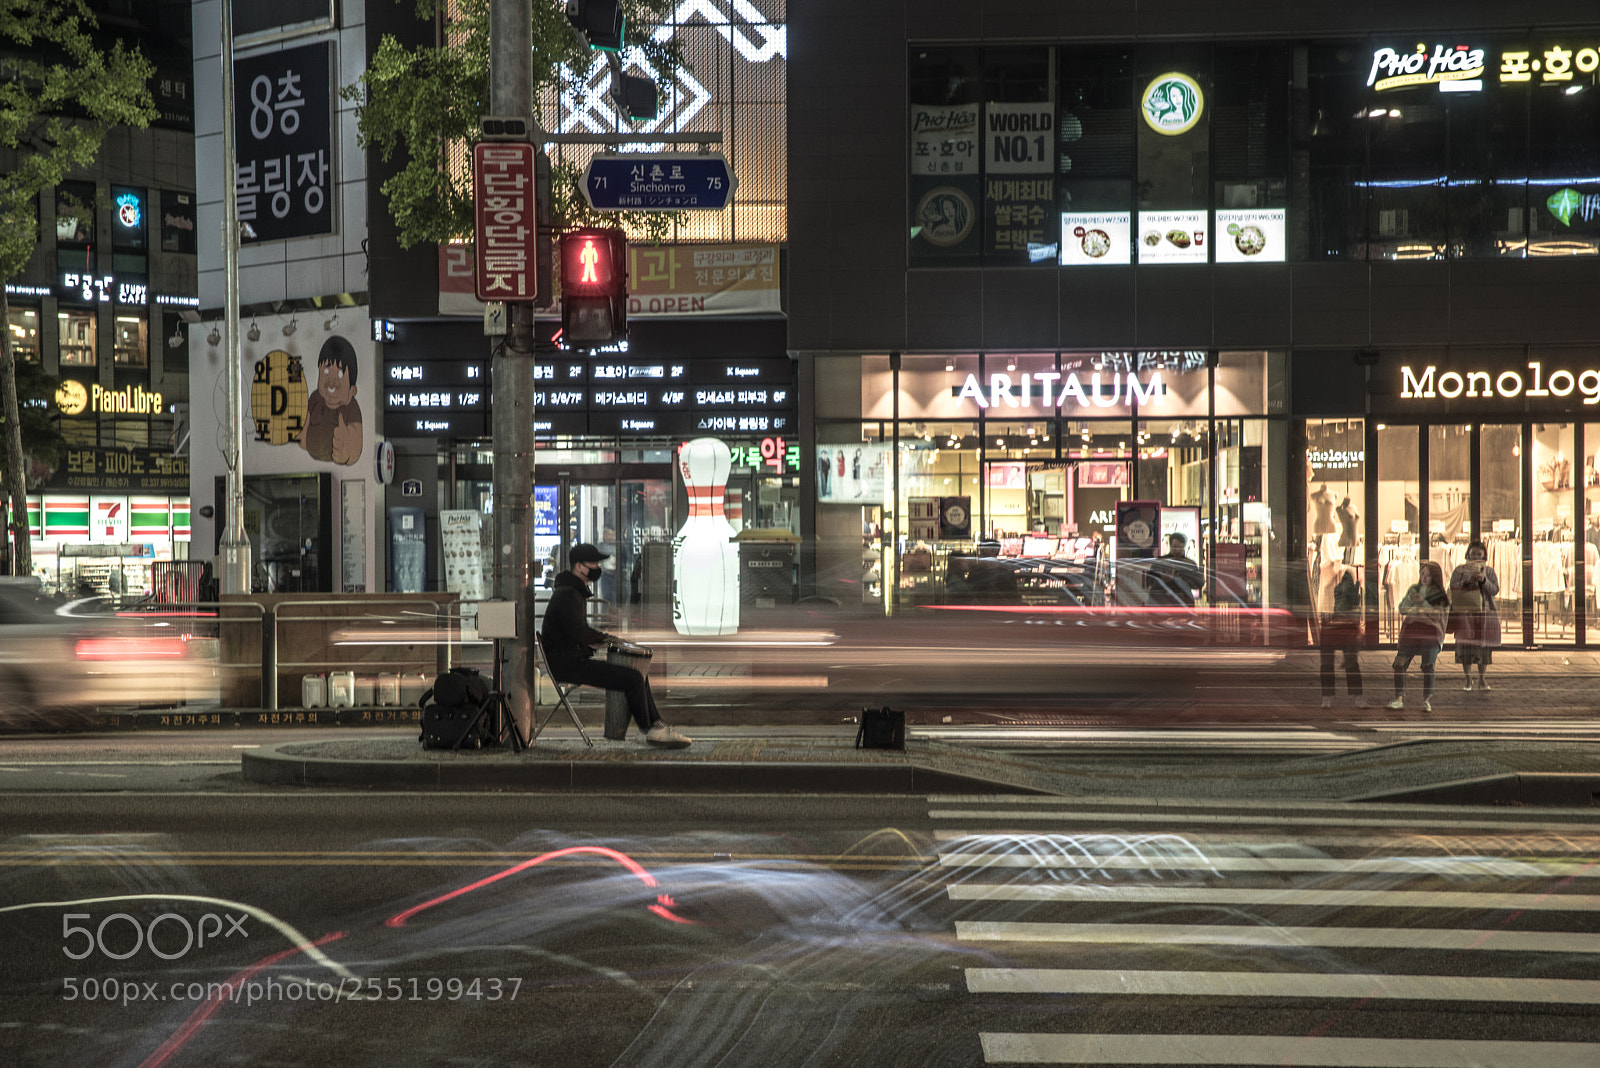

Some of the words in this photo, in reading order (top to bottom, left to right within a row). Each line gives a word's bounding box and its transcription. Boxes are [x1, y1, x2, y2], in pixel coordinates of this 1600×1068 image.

[160, 79, 186, 99] 센터
[250, 69, 305, 140] 8층
[989, 113, 1052, 132] WORLD
[994, 135, 1045, 162] NO.1
[631, 164, 685, 182] 신촌로
[236, 149, 329, 220] 볼링장
[594, 177, 607, 189] 71
[630, 181, 686, 193] Sinchon-ro
[706, 177, 722, 190] 75
[986, 180, 1053, 201] 세계최대
[482, 149, 530, 296] 무단횡단금지
[995, 205, 1045, 226] 쌀국수
[119, 292, 146, 304] CAFE
[650, 297, 705, 313] OPEN
[467, 366, 479, 378] B1
[569, 366, 582, 378] 2F
[670, 365, 684, 377] 2F
[955, 371, 1165, 408] ARITAUM
[92, 383, 162, 414] PianoLibre
[271, 386, 287, 416] D
[389, 394, 406, 406] NH
[408, 392, 451, 407] 농협은행
[458, 393, 480, 405] 1/2F
[595, 391, 647, 405] 메가스터디
[737, 391, 768, 404] 피부과
[697, 417, 736, 431] 스카이락
[161, 714, 221, 725] 자전거주의
[258, 712, 318, 724] 자전거주의
[362, 710, 421, 722] 자전거주의
